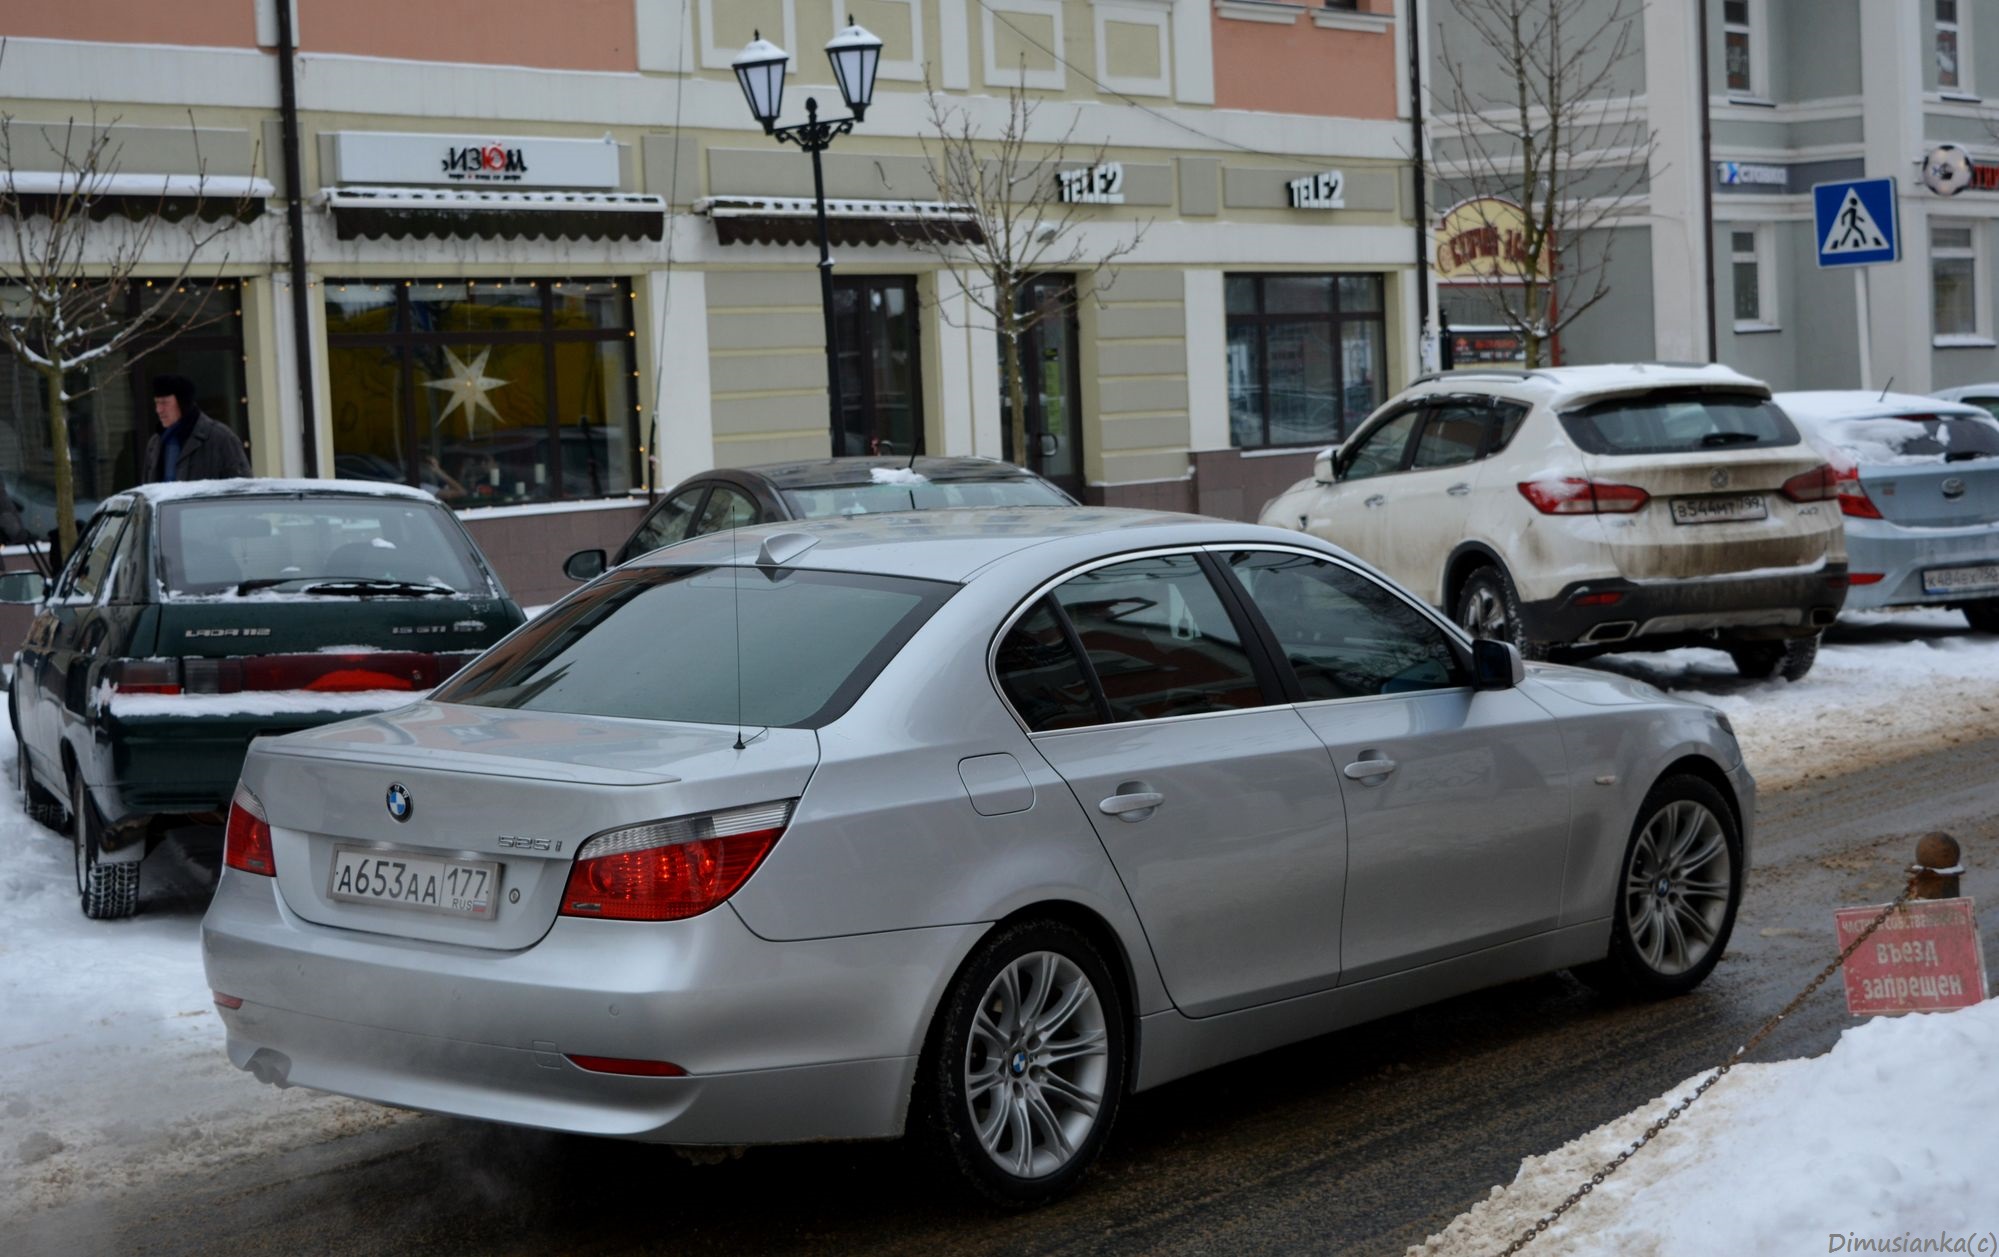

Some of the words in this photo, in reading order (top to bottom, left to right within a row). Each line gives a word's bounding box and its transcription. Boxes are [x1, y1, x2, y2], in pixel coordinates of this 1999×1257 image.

[1058, 163, 1124, 204] TELE2
[1287, 170, 1344, 209] TELE2
[185, 629, 239, 637] LADA
[338, 859, 438, 904] А653АА
[447, 867, 488, 899] 177
[452, 898, 473, 912] RUS
[1862, 974, 1963, 1004] запрещен
